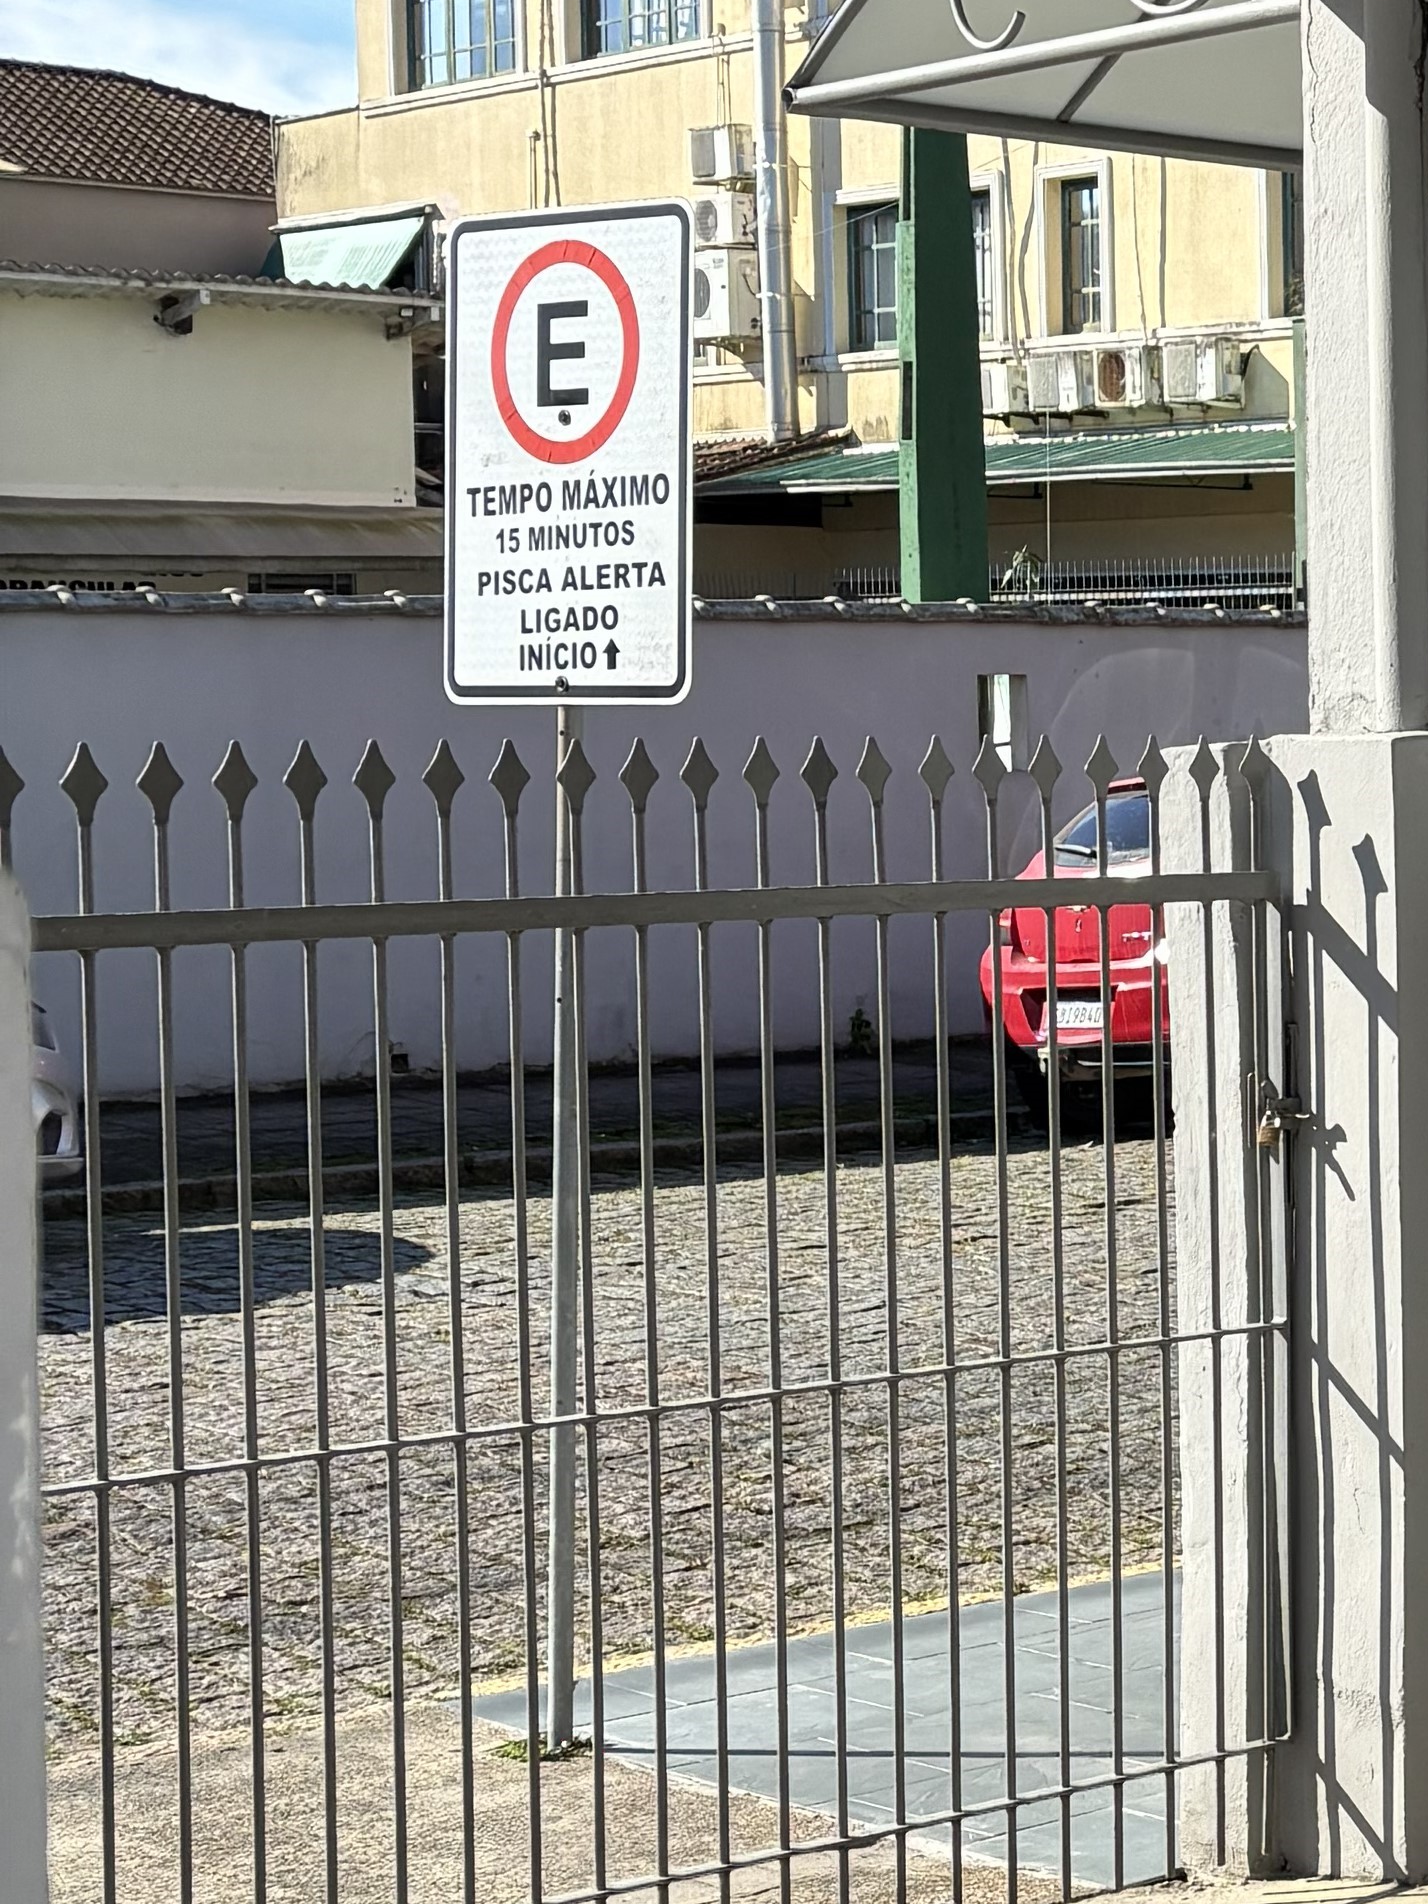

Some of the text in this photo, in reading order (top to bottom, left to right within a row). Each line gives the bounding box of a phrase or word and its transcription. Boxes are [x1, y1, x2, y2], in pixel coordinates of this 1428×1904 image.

[536, 299, 589, 407] E
[466, 470, 670, 517] TEMPO MÁXIMO
[496, 520, 636, 554] 15 MINUTOS
[477, 561, 666, 596] PISCA ALERTA
[520, 604, 619, 634] LIGADO
[519, 637, 597, 671] INÍCIO
